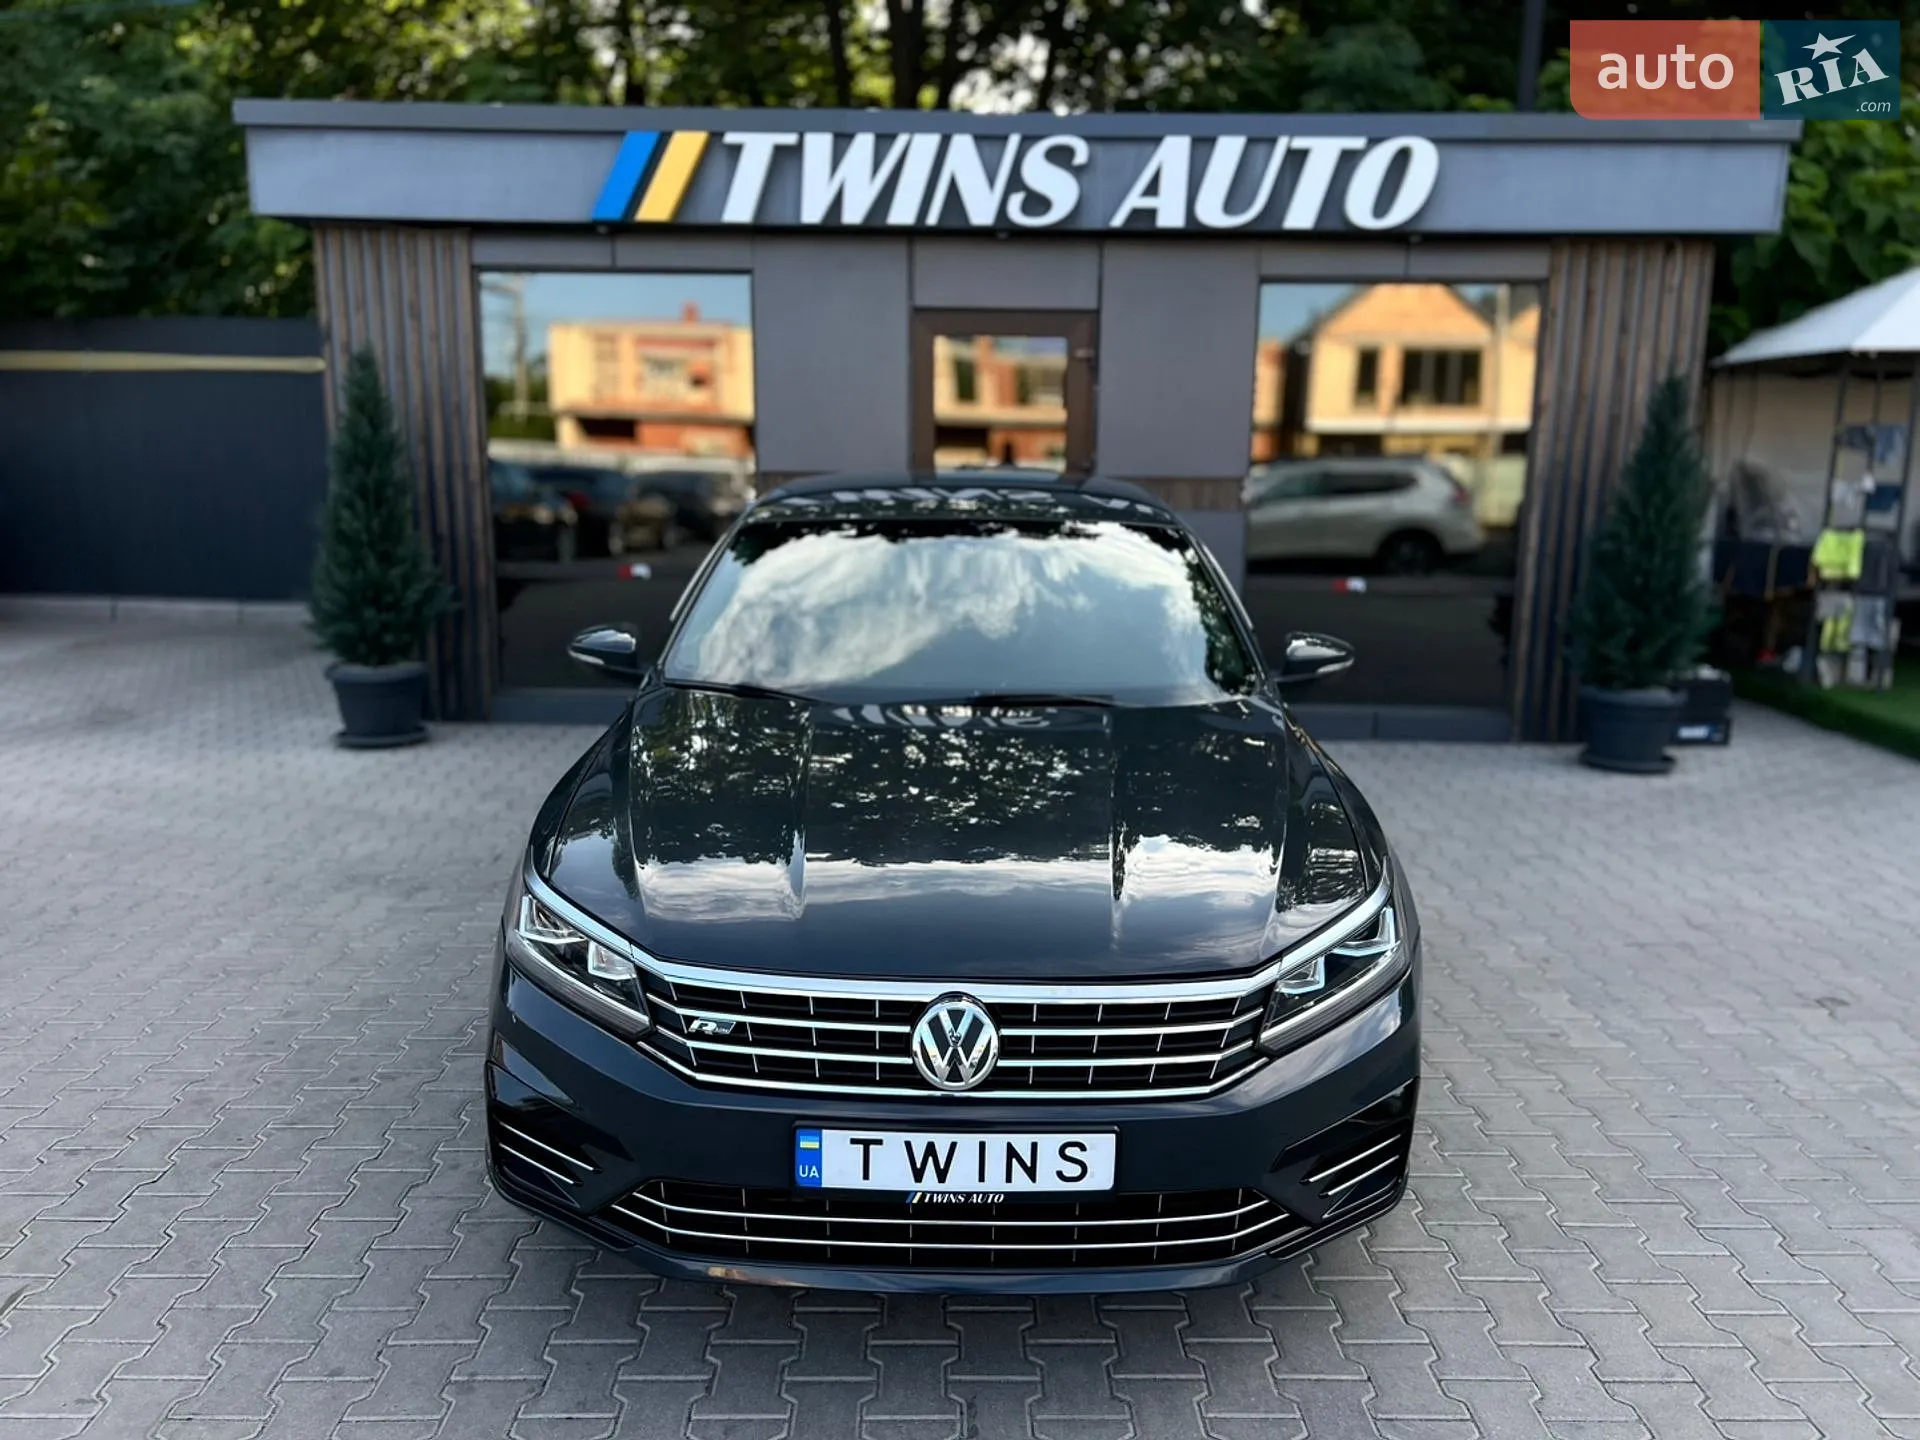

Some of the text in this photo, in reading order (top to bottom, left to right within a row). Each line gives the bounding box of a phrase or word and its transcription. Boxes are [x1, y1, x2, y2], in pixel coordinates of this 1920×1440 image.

[720, 130, 1441, 232] TWINS AUTO
[799, 1164, 820, 1178] UA
[924, 1191, 1005, 1204] TWINS AUTO
